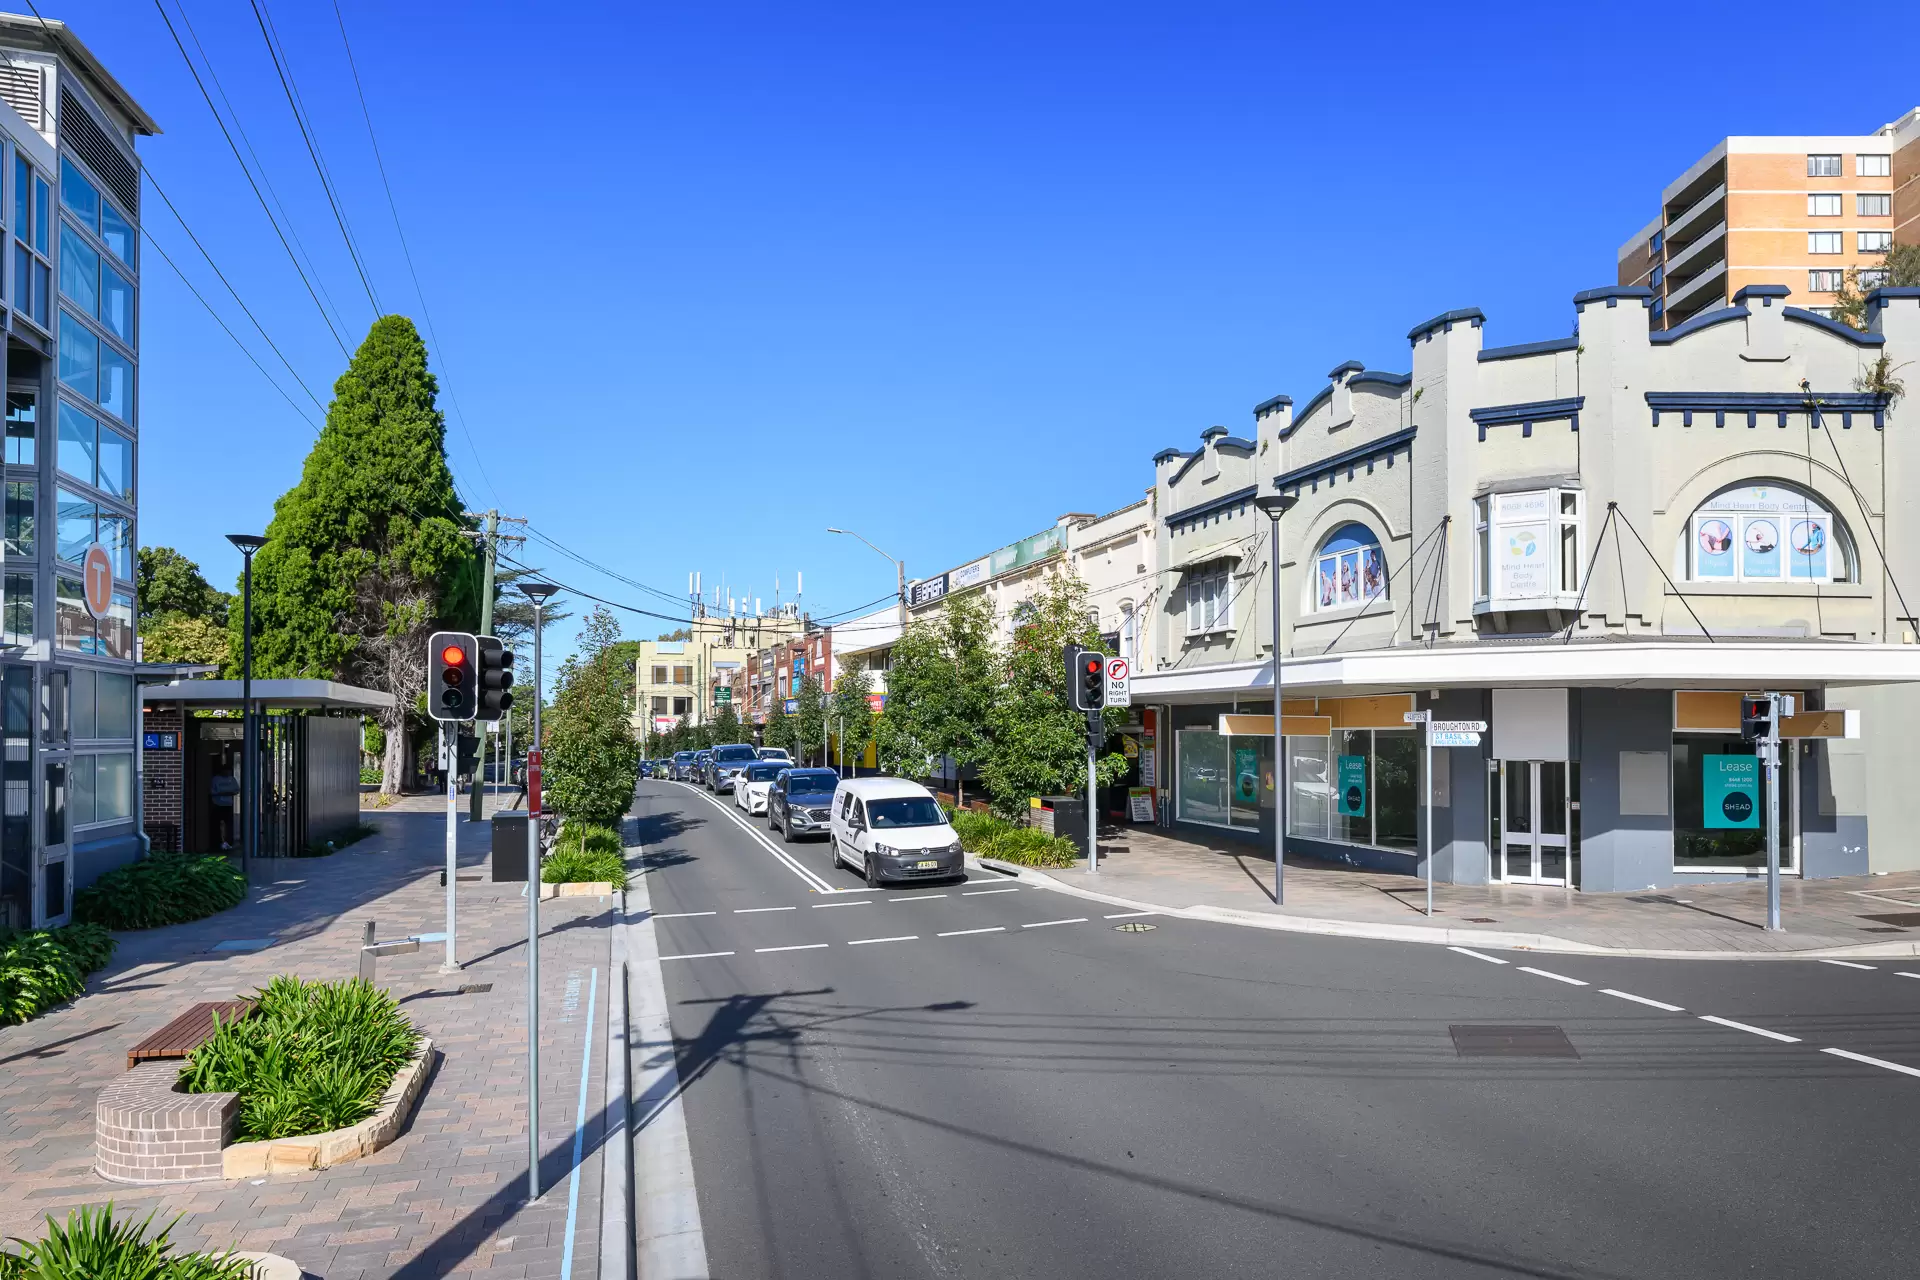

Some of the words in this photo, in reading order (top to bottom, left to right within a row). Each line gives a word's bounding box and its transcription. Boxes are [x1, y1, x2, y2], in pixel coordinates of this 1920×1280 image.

[1710, 501, 1731, 509] Mind
[1758, 502, 1780, 511] Body
[1782, 502, 1810, 510] Centre
[1513, 571, 1533, 580] Body
[92, 561, 106, 605] T
[1510, 580, 1537, 589] Centre
[1111, 681, 1124, 689] NO
[1433, 722, 1470, 731] BROUGHTON
[1471, 722, 1480, 731] RD
[1345, 759, 1362, 770] Lease
[1719, 760, 1753, 772] Lease
[1724, 803, 1751, 811] SHEAD
